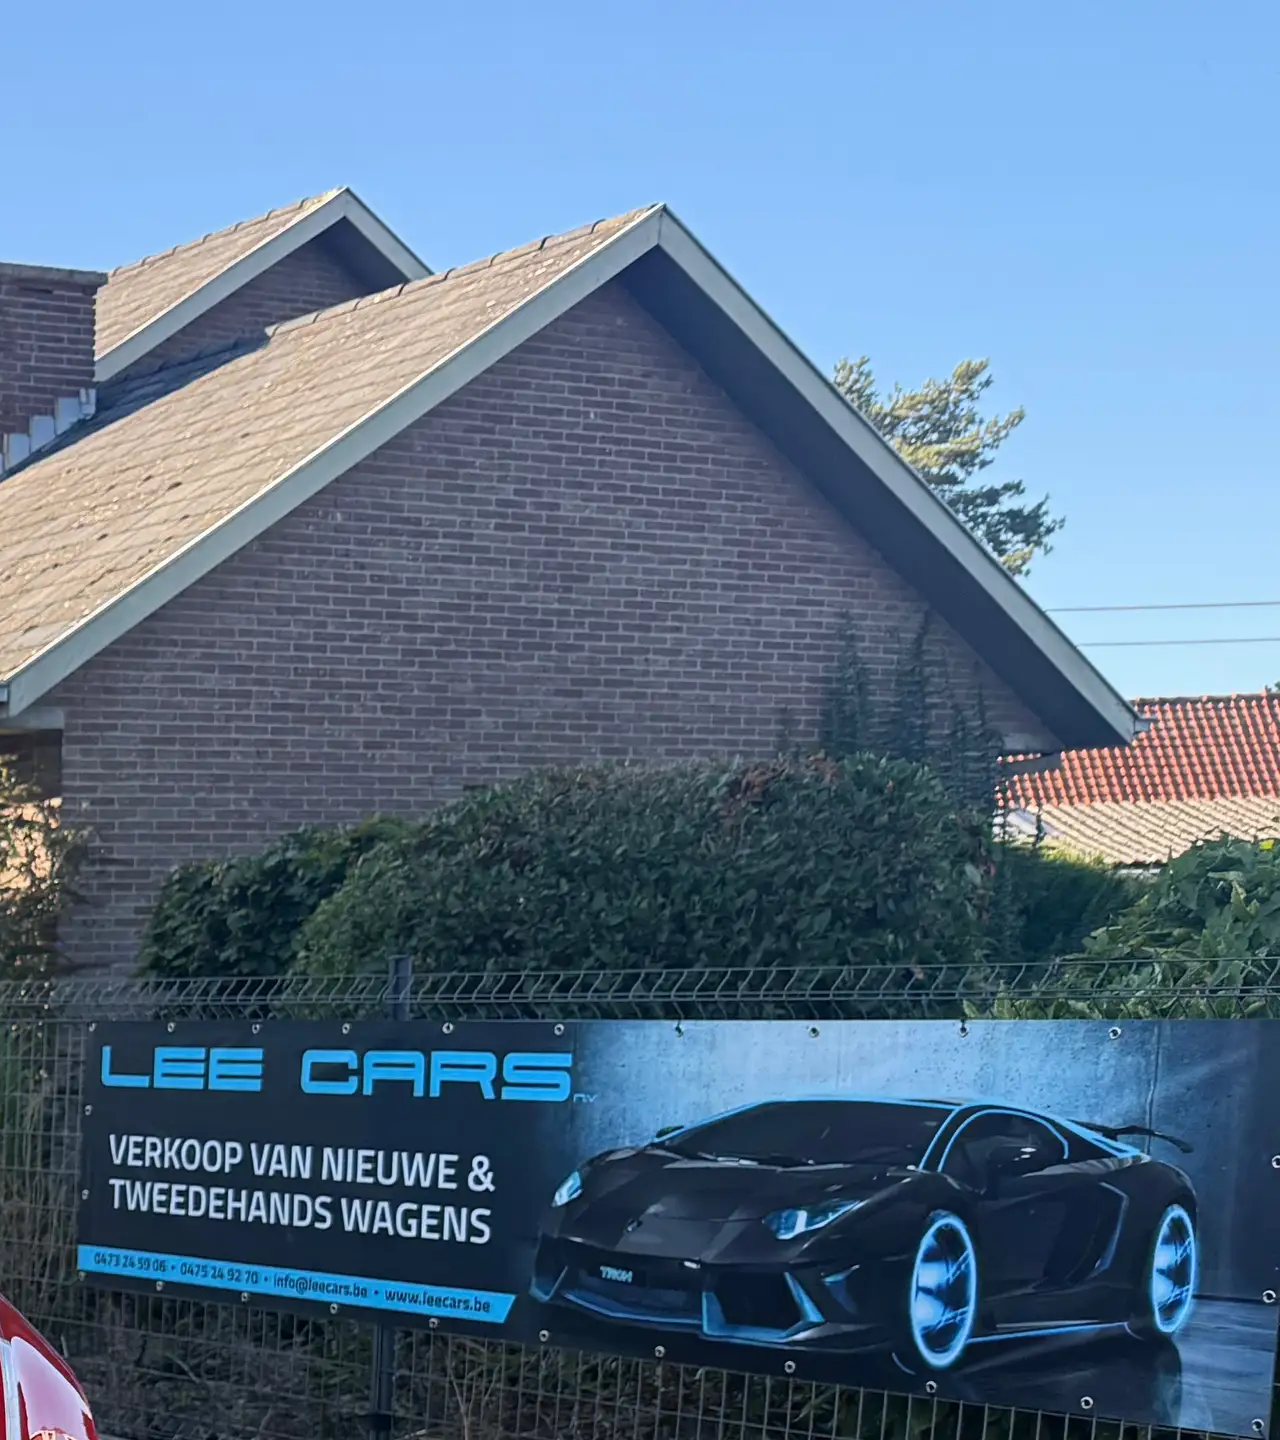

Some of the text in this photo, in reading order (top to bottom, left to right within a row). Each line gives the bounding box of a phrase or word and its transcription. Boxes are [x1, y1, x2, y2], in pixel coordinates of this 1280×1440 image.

[100, 1045, 263, 1092] LEE
[300, 1049, 572, 1101] CARS
[109, 1134, 496, 1193] VERKOOP VAN NIEUWE &
[109, 1178, 492, 1244] TWEEDEHANDS WAGENS
[273, 1273, 369, 1300] info@leecars.be
[384, 1288, 492, 1314] www.leecars.be
